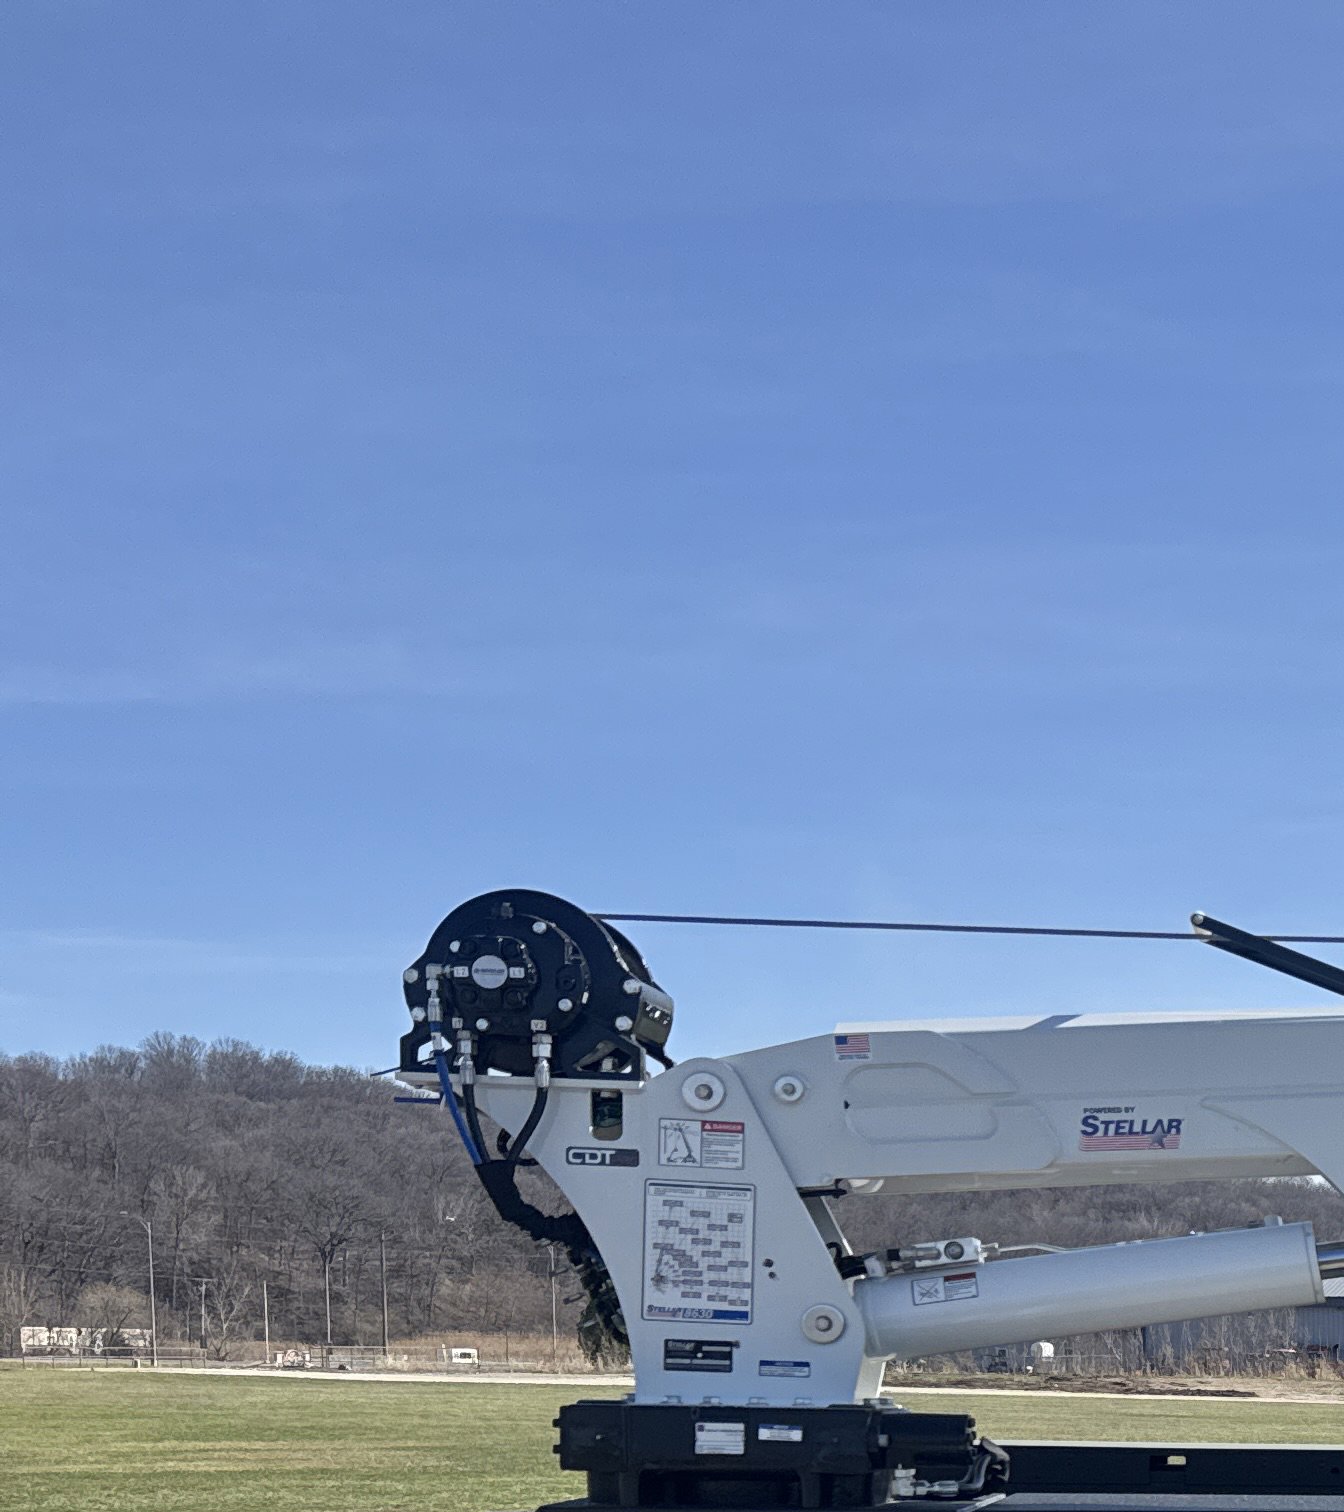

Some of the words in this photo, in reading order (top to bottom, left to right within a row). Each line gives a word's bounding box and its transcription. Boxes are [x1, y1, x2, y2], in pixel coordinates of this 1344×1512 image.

[1083, 1106, 1122, 1114] POWERED
[1080, 1114, 1182, 1136] STELLAR
[568, 1149, 616, 1165] CDT
[647, 1304, 682, 1314] STELLAR
[684, 1309, 714, 1318] 8630
